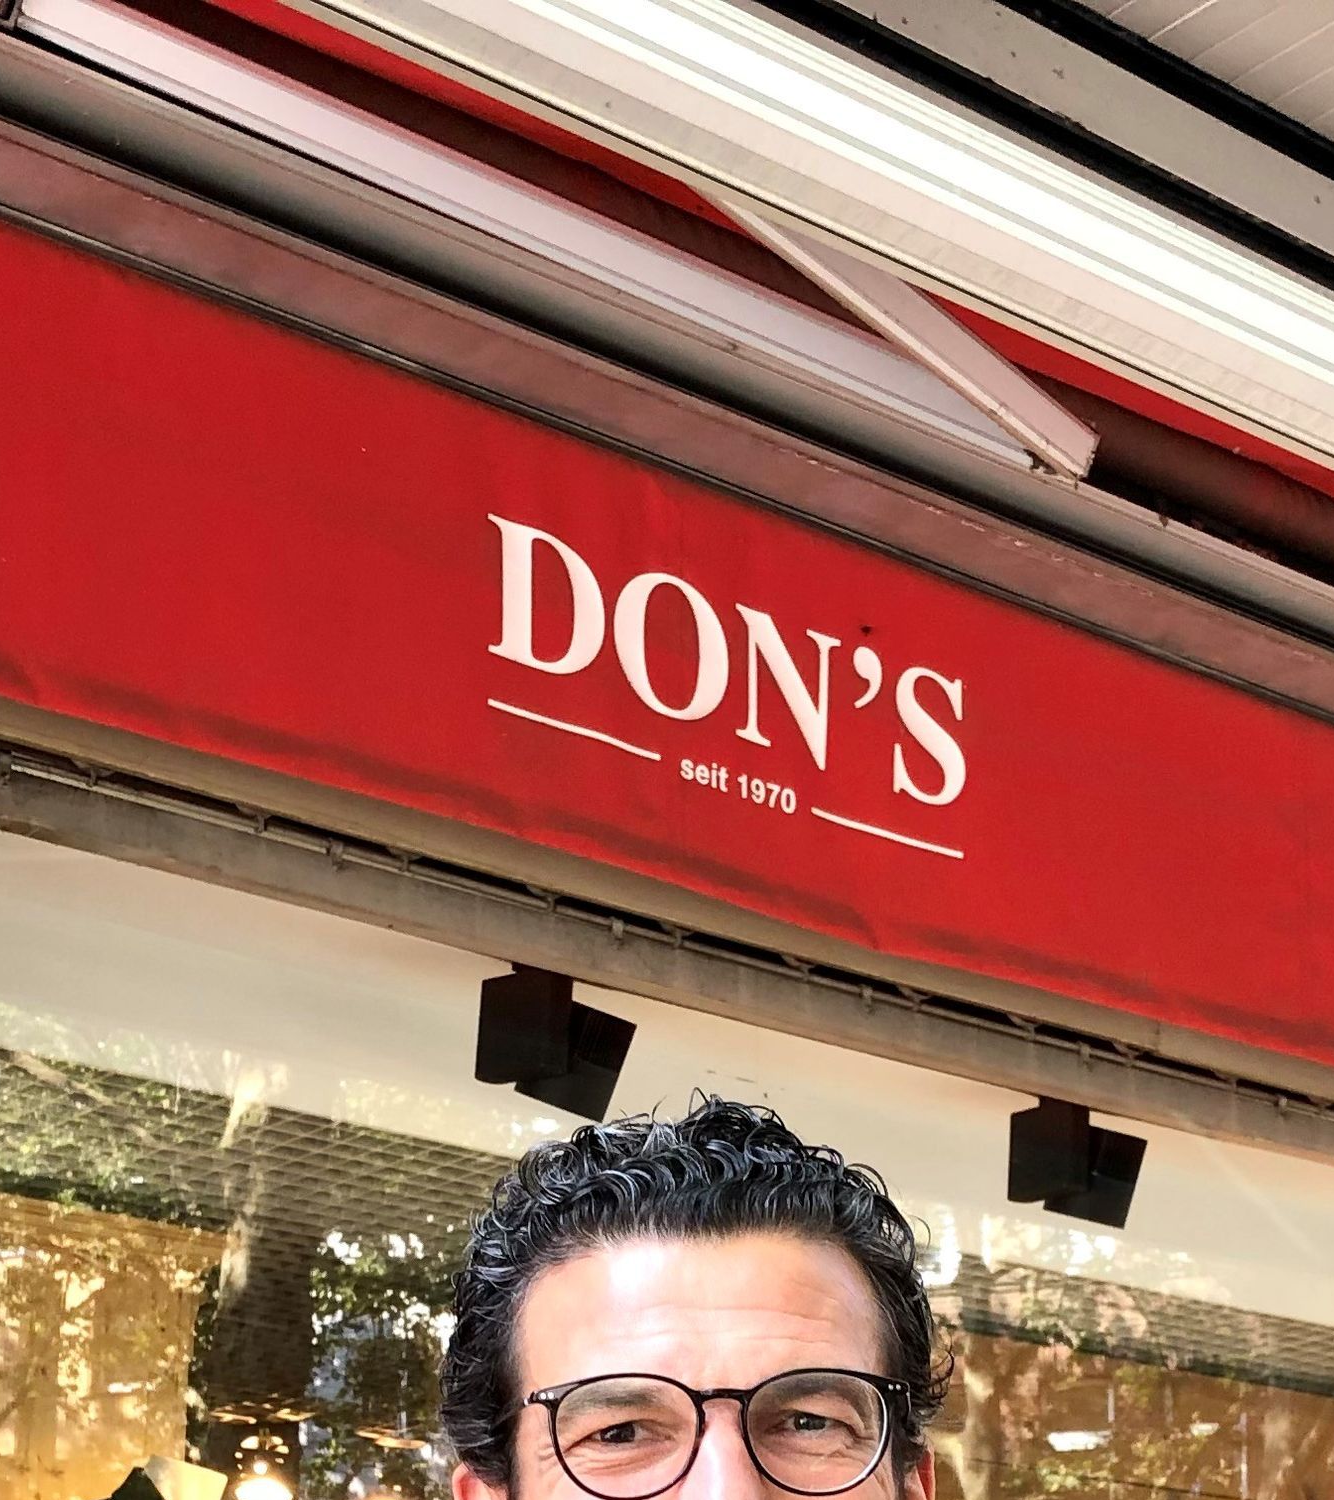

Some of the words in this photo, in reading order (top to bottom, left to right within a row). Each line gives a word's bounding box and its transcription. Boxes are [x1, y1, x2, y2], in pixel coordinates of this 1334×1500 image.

[487, 513, 967, 806] DON'S
[679, 758, 729, 793] seit
[737, 773, 797, 814] 1970
